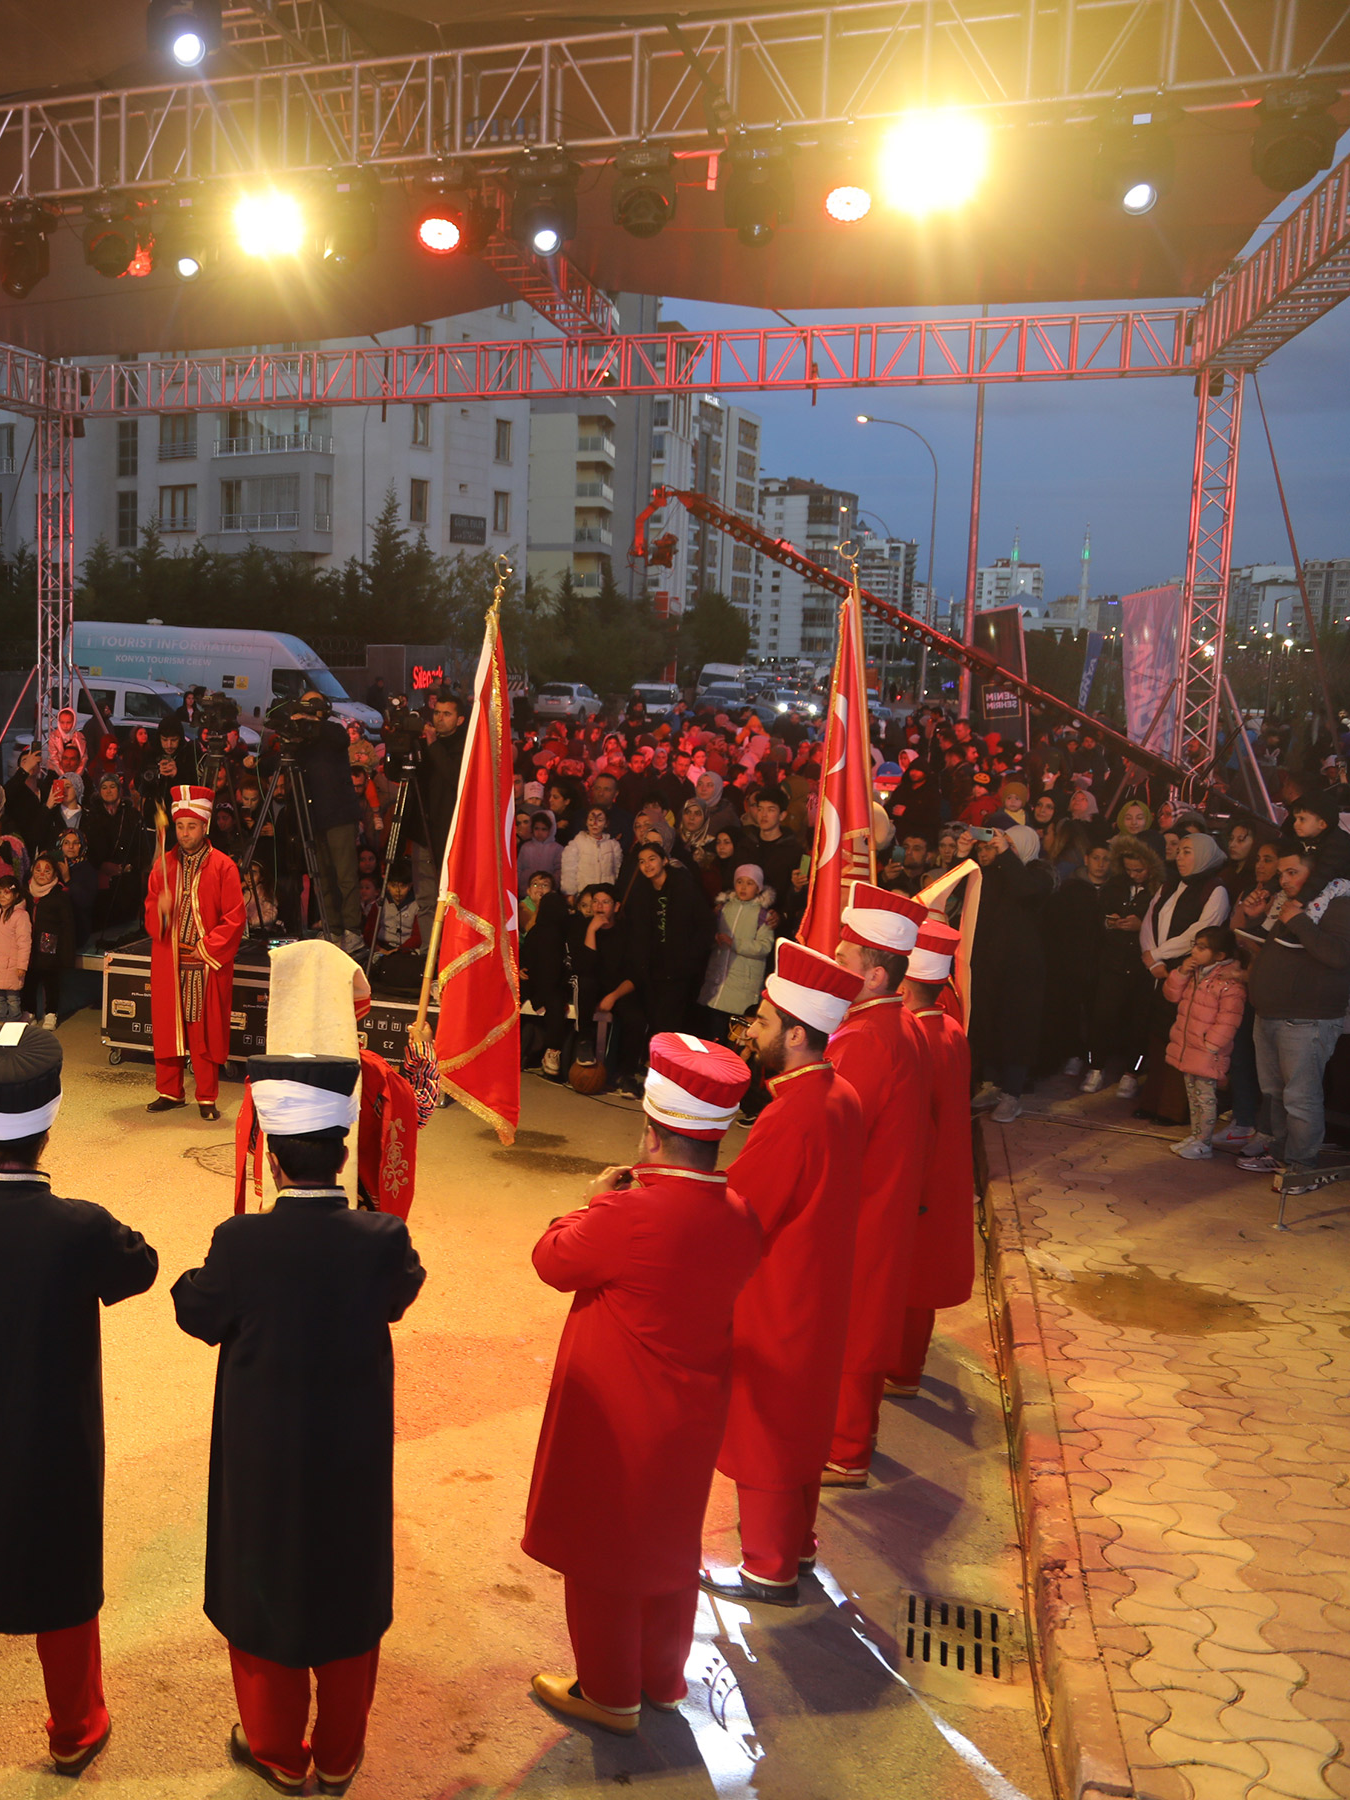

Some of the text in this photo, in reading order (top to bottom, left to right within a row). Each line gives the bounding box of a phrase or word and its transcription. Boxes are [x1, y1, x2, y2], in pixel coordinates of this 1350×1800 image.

[100, 635, 255, 653] TOURIST INFORMATION
[115, 654, 212, 667] KONYA TOURISM CREW
